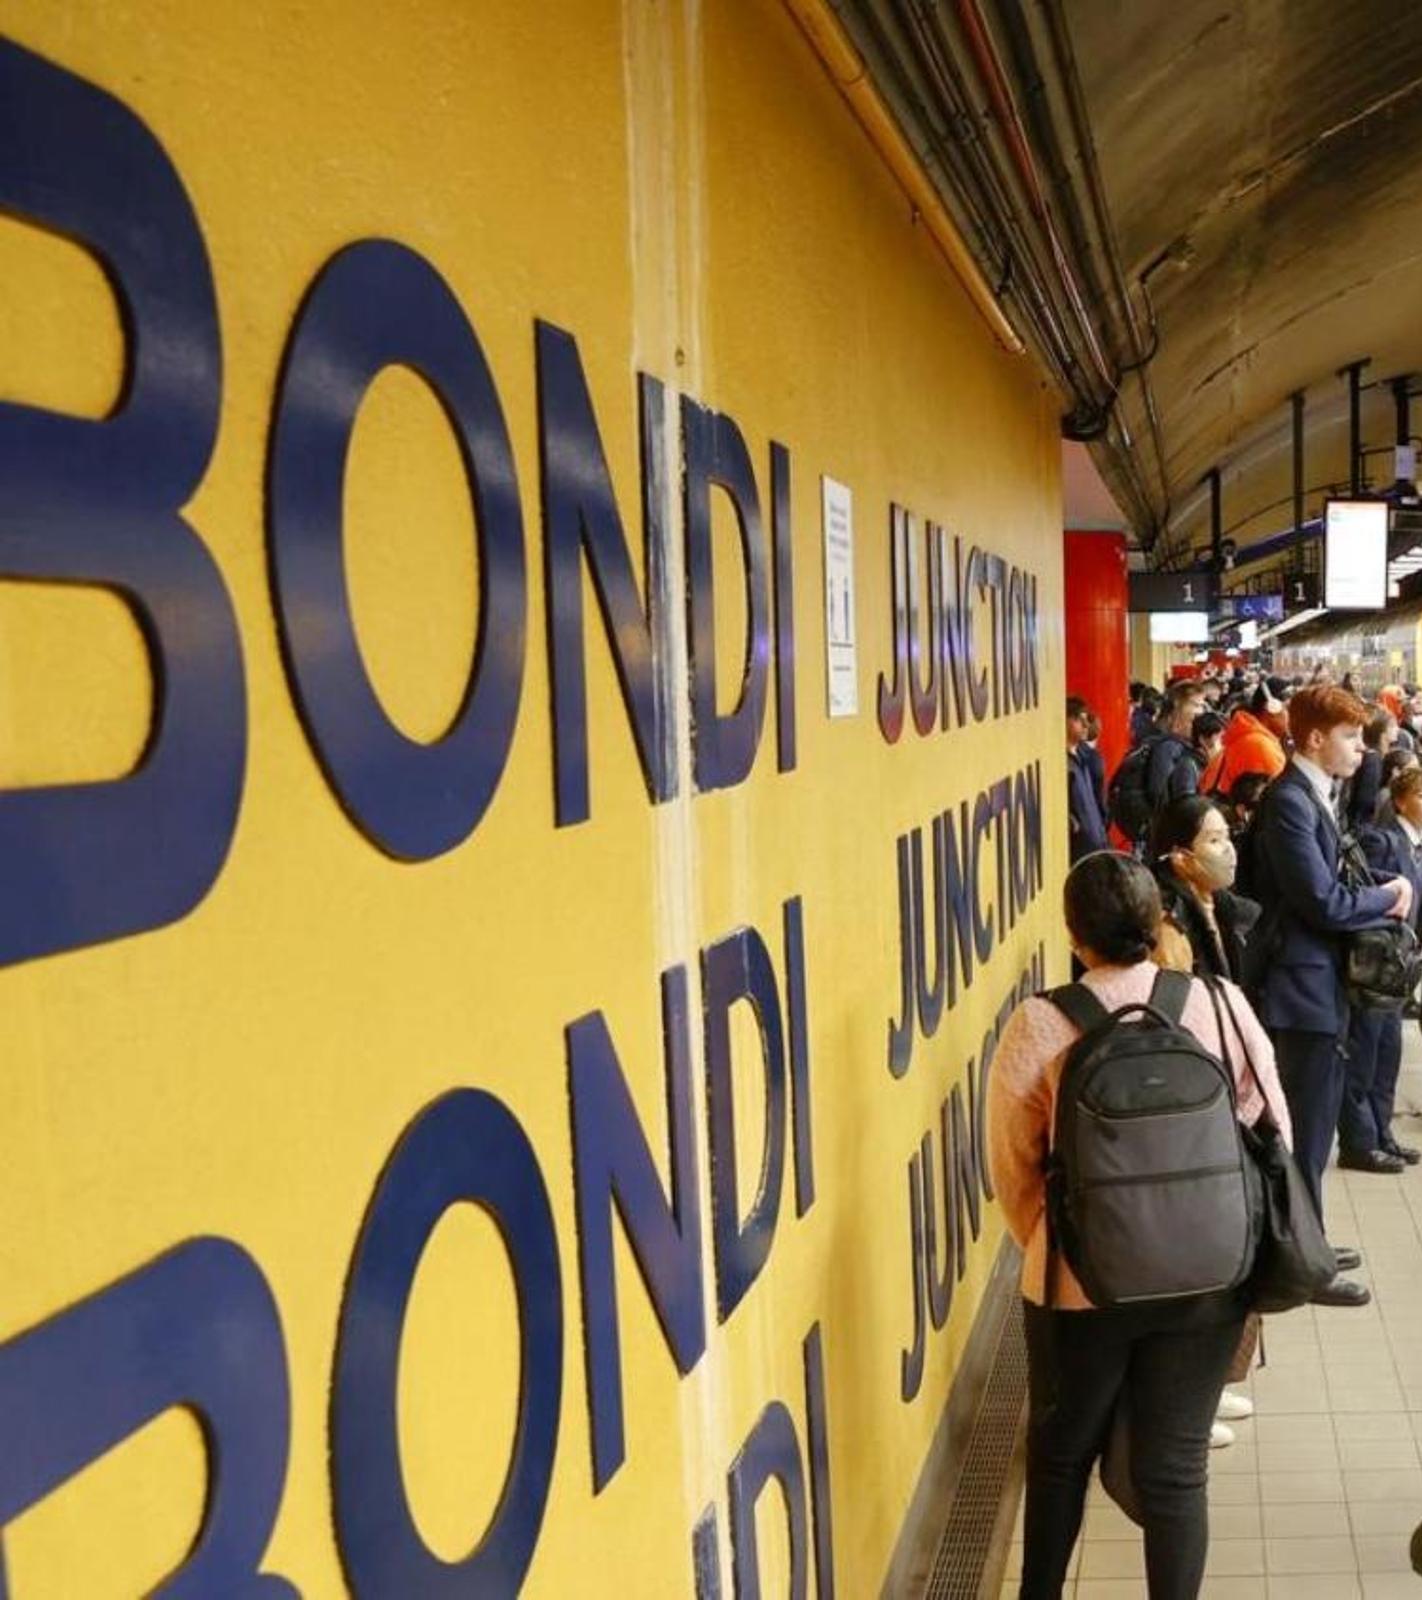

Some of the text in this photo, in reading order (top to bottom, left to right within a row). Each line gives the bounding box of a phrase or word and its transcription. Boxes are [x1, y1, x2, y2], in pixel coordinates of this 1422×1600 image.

[0, 34, 1040, 968] BONDI JUNCTION
[1184, 583, 1194, 602] 1
[1296, 583, 1305, 601] 1
[887, 759, 1043, 1081] JUNCTION
[902, 941, 1045, 1404] JUNC
